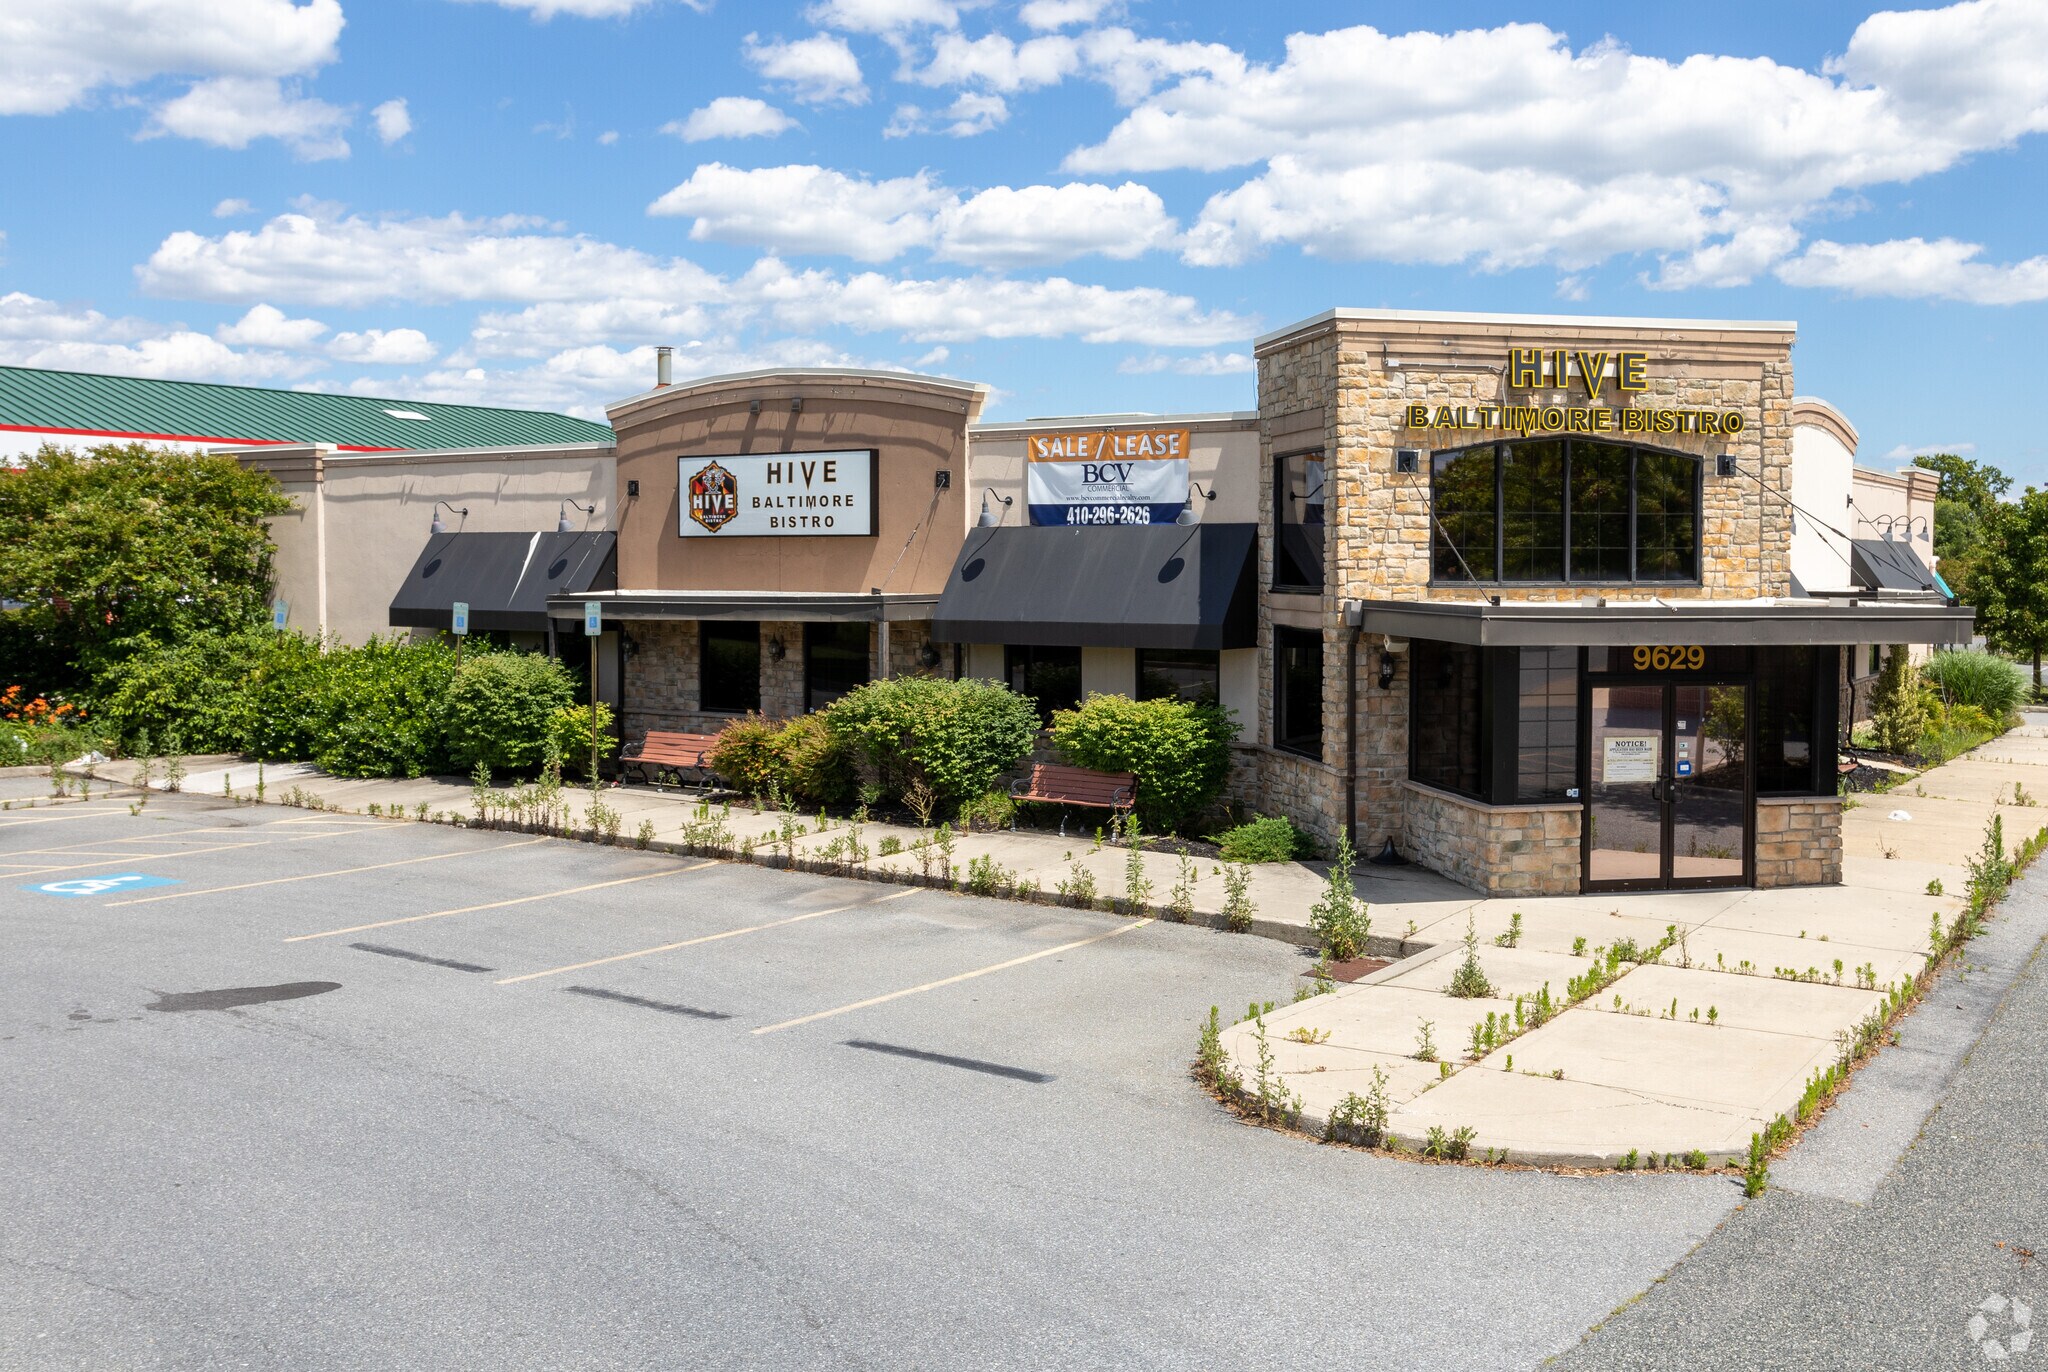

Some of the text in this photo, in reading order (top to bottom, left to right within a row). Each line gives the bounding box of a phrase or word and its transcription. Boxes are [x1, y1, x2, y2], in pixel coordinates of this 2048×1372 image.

[1509, 348, 1649, 399] HIVE
[1407, 405, 1745, 437] BALTIMORE BISTRO
[1037, 433, 1180, 460] SALE / LEASE
[766, 460, 837, 490] HIVE
[1081, 463, 1134, 484] BCV
[1066, 494, 1151, 502] www.bcvcommercialrealty.com
[1087, 485, 1130, 493] COMMERCIAL
[693, 494, 734, 514] HIVE
[752, 494, 854, 510] BALTIMORE
[770, 516, 835, 528] BISTRO
[1066, 506, 1150, 525] 410-296-2626
[1633, 646, 1705, 670] 9629
